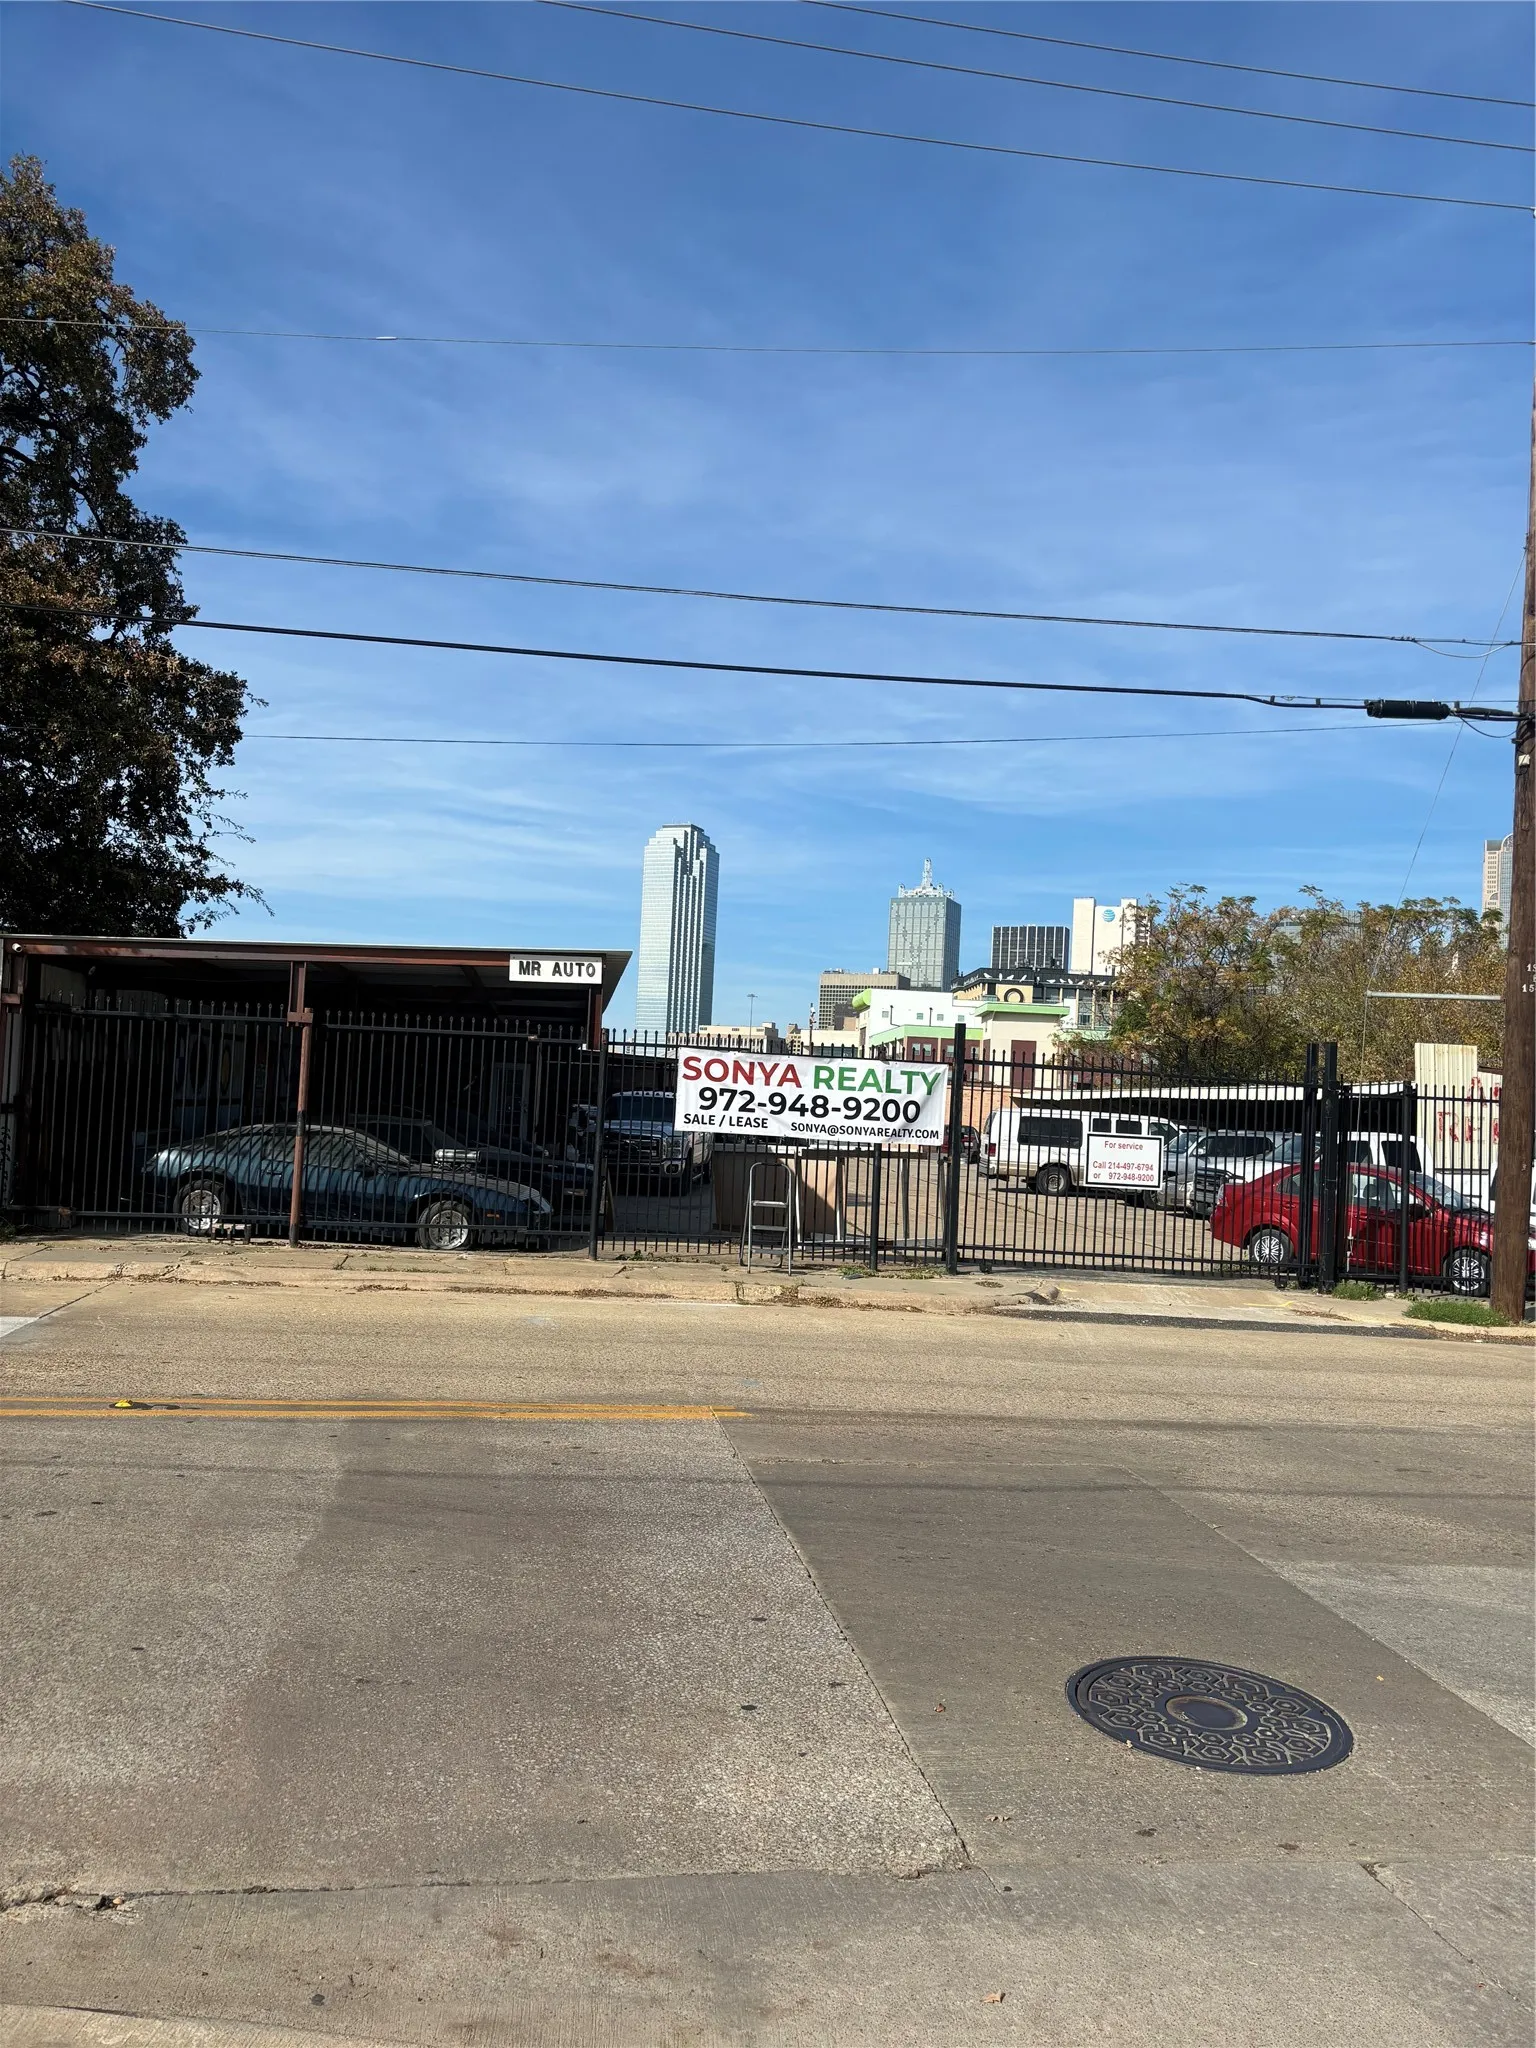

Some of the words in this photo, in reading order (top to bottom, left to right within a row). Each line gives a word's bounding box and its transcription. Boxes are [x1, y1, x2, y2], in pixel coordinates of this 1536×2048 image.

[519, 961, 541, 976] MR
[552, 962, 596, 977] AUTO
[682, 1056, 802, 1088] SONYA
[813, 1065, 941, 1095] REALTY
[699, 1087, 920, 1123] 972-948-9200
[683, 1113, 716, 1126] SALE
[719, 1115, 726, 1127] /
[729, 1116, 768, 1128] LEASE
[791, 1121, 939, 1139] SONYA@SONYAREALTY.COM
[1104, 1141, 1116, 1149] For
[1118, 1142, 1143, 1150] service
[1093, 1161, 1106, 1169] Call
[1108, 1162, 1154, 1171] 214-497-6794
[1108, 1172, 1154, 1182] 972-948-9200
